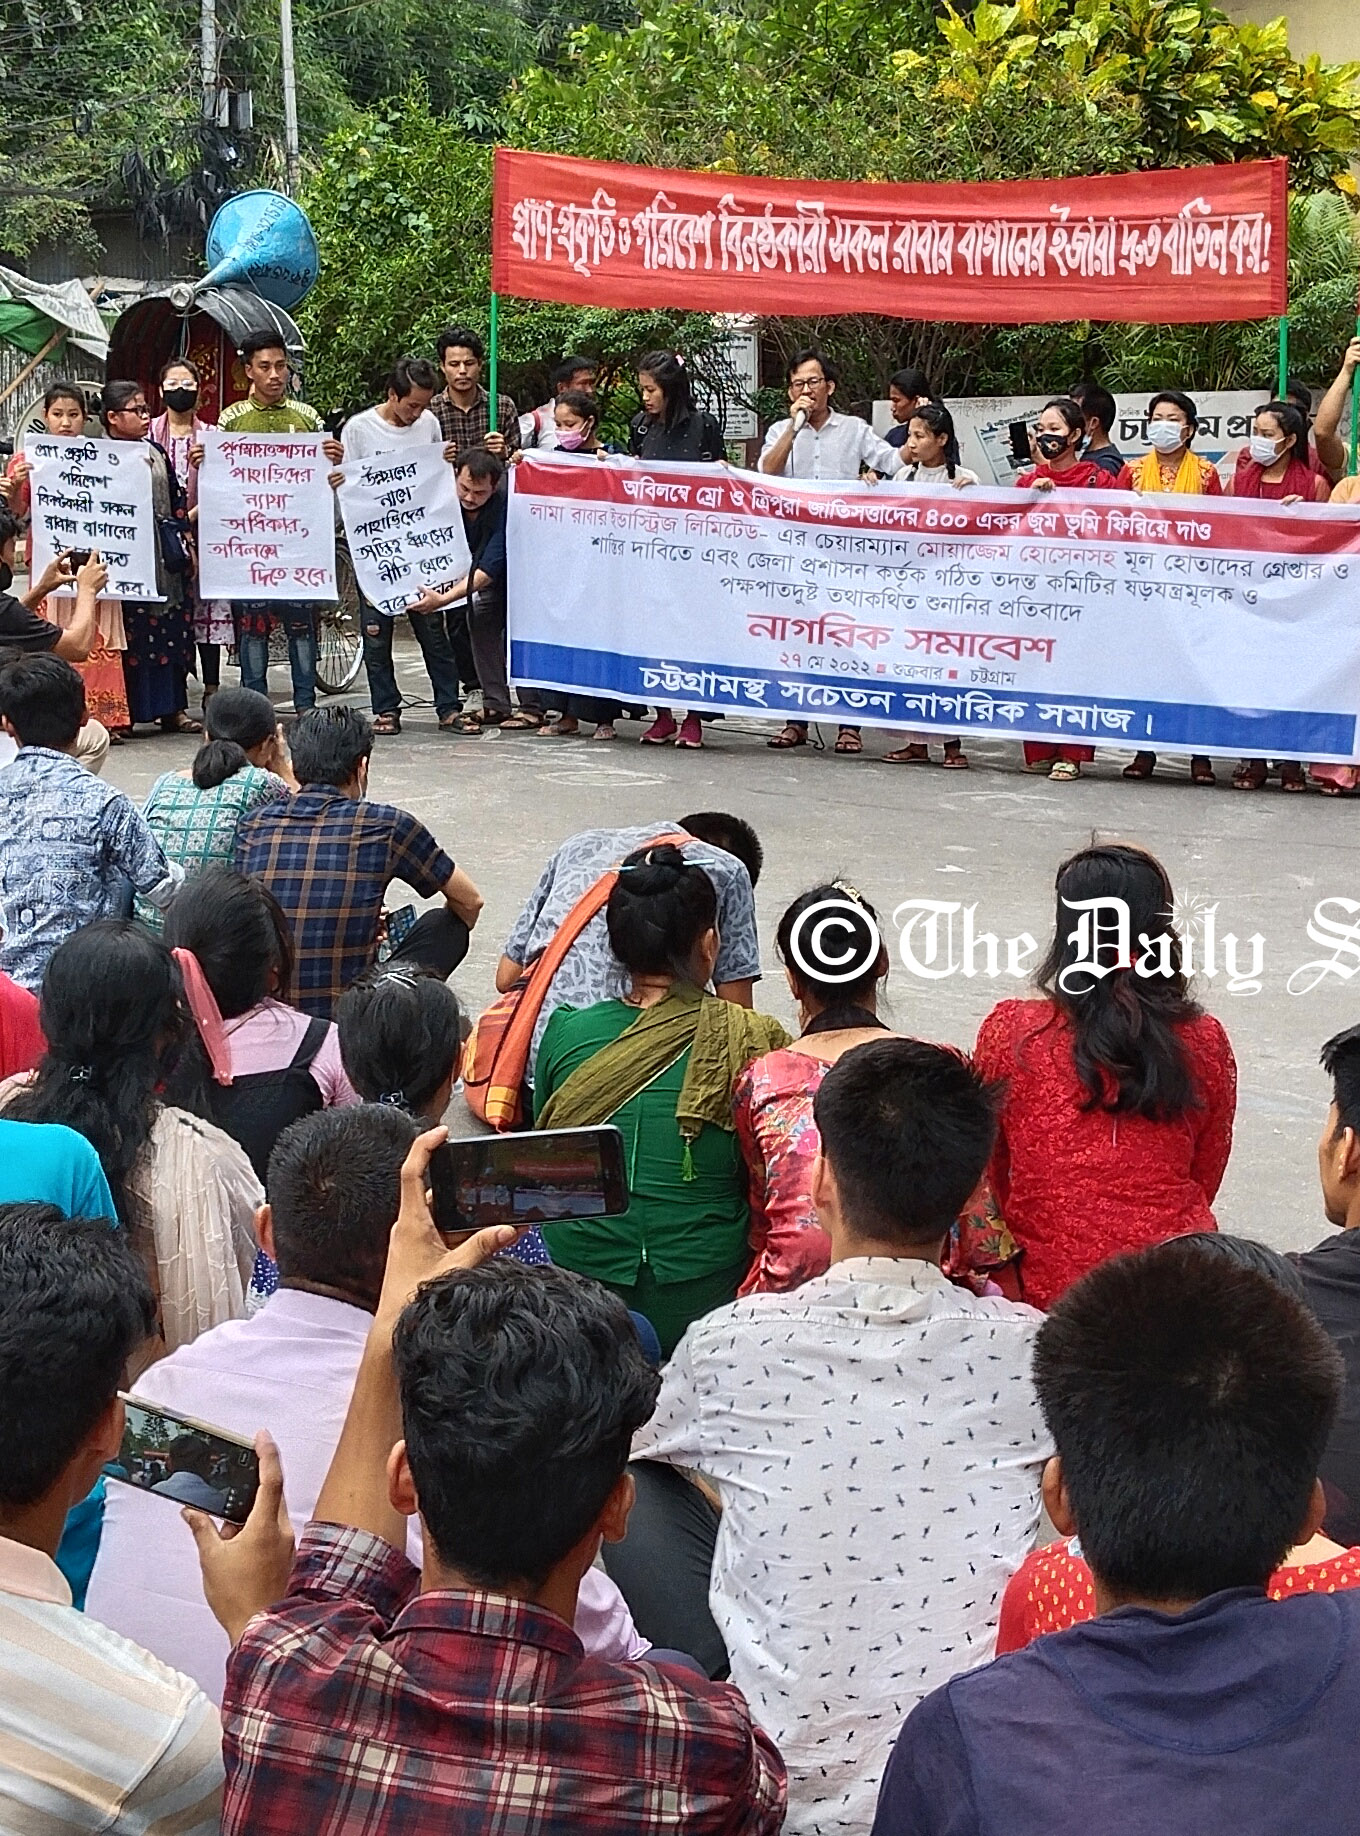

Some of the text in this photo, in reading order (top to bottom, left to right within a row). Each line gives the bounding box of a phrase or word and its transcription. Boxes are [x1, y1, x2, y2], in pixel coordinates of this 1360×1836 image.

[618, 219, 631, 254] ও
[632, 190, 714, 270] পরিবেশ
[829, 214, 893, 274] সকল
[892, 219, 956, 275] রাবার
[958, 219, 1048, 276] বাগানের
[1049, 203, 1117, 276] ইজারা
[1119, 218, 1161, 276] দ্রুত
[1162, 197, 1229, 275] বাতিল
[1230, 212, 1272, 275] কর!
[59, 467, 112, 489] পরিবেশ
[83, 520, 137, 541] বাগানের
[100, 501, 137, 518] সকল
[622, 476, 1212, 542] অবিলম্বে ম্রো ও ত্রিপুরা জাতিসত্তাদের ৪০০ একর জুম ভূমি ফিরিয়ে দাও
[529, 502, 563, 525] লামা
[572, 507, 607, 527] রাবার
[611, 505, 679, 535] ইন্ডাস্ট্রিজ
[778, 529, 806, 548] এর
[815, 532, 910, 557] চেয়ারম্যান
[917, 541, 1014, 562] মোয়াজ্জেম
[1020, 545, 1118, 569] হোসেনসহ
[1124, 551, 1156, 576] মূল
[1163, 553, 1255, 578] হোতাদের
[1262, 560, 1326, 581] গ্রেপ্তার
[1333, 563, 1349, 580] ও
[248, 562, 289, 586] দিতে
[376, 556, 413, 586] নীতি
[631, 537, 695, 561] দাবিতে
[701, 548, 740, 570] এবং
[747, 552, 796, 573] জেলা
[800, 556, 869, 581] প্রশাসন
[876, 560, 928, 592] কর্তৃক
[935, 562, 984, 588] গঠিত
[990, 571, 1039, 591] তদন্ত
[1045, 569, 1117, 596] কমিটির
[1124, 579, 1235, 609] ষড়যন্ত্রমূলক
[1242, 589, 1258, 606] ও
[720, 577, 1084, 622] পক্ষপাতদুষ্ট তথাকথিত শুনানির প্রতিবাদে
[747, 612, 1057, 663] নাগরিক সমাবেশ
[779, 652, 1017, 686] ২৭ মে ২০২২ শুক্রবার চট্টগ্রাম
[639, 661, 771, 707] চট্টগ্রামস্থ
[778, 680, 896, 715] সচেতন
[903, 691, 1029, 723] নাগরিক
